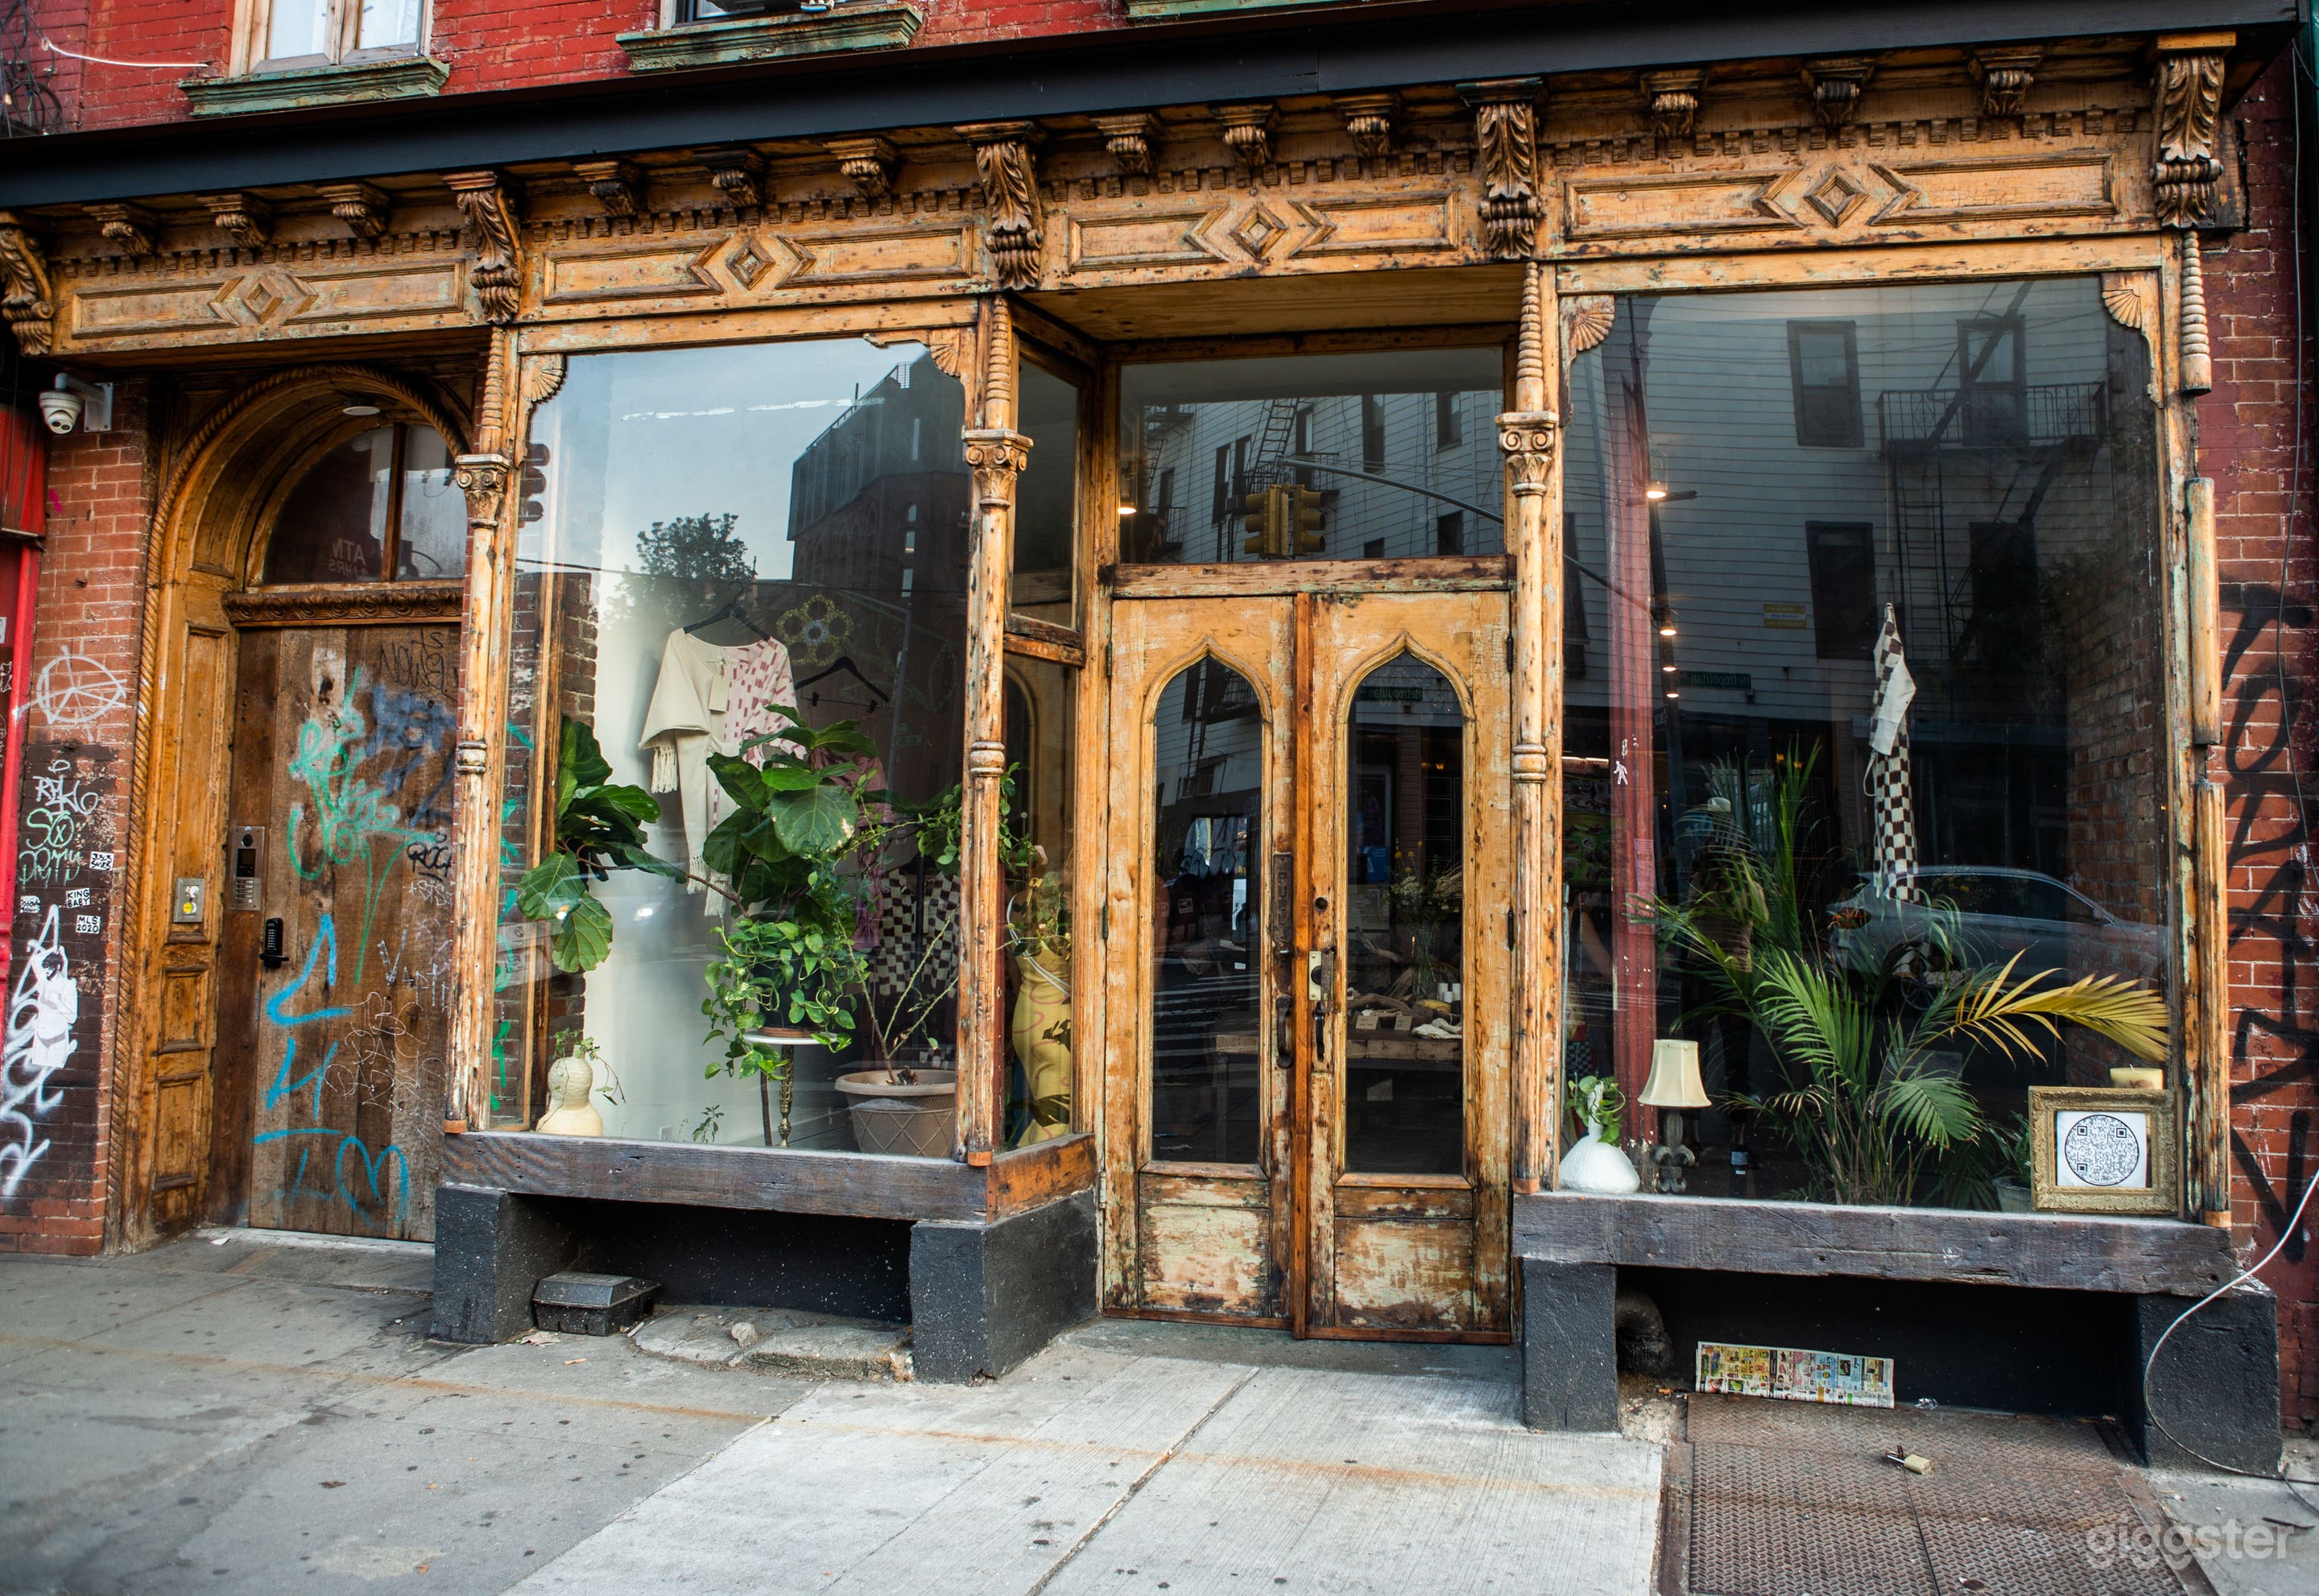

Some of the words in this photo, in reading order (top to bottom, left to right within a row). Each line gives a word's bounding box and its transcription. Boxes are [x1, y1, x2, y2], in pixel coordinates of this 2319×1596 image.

[68, 889, 90, 900] KING
[68, 897, 90, 908] BABY
[78, 916, 98, 925] MLS
[77, 924, 99, 933] 2020
